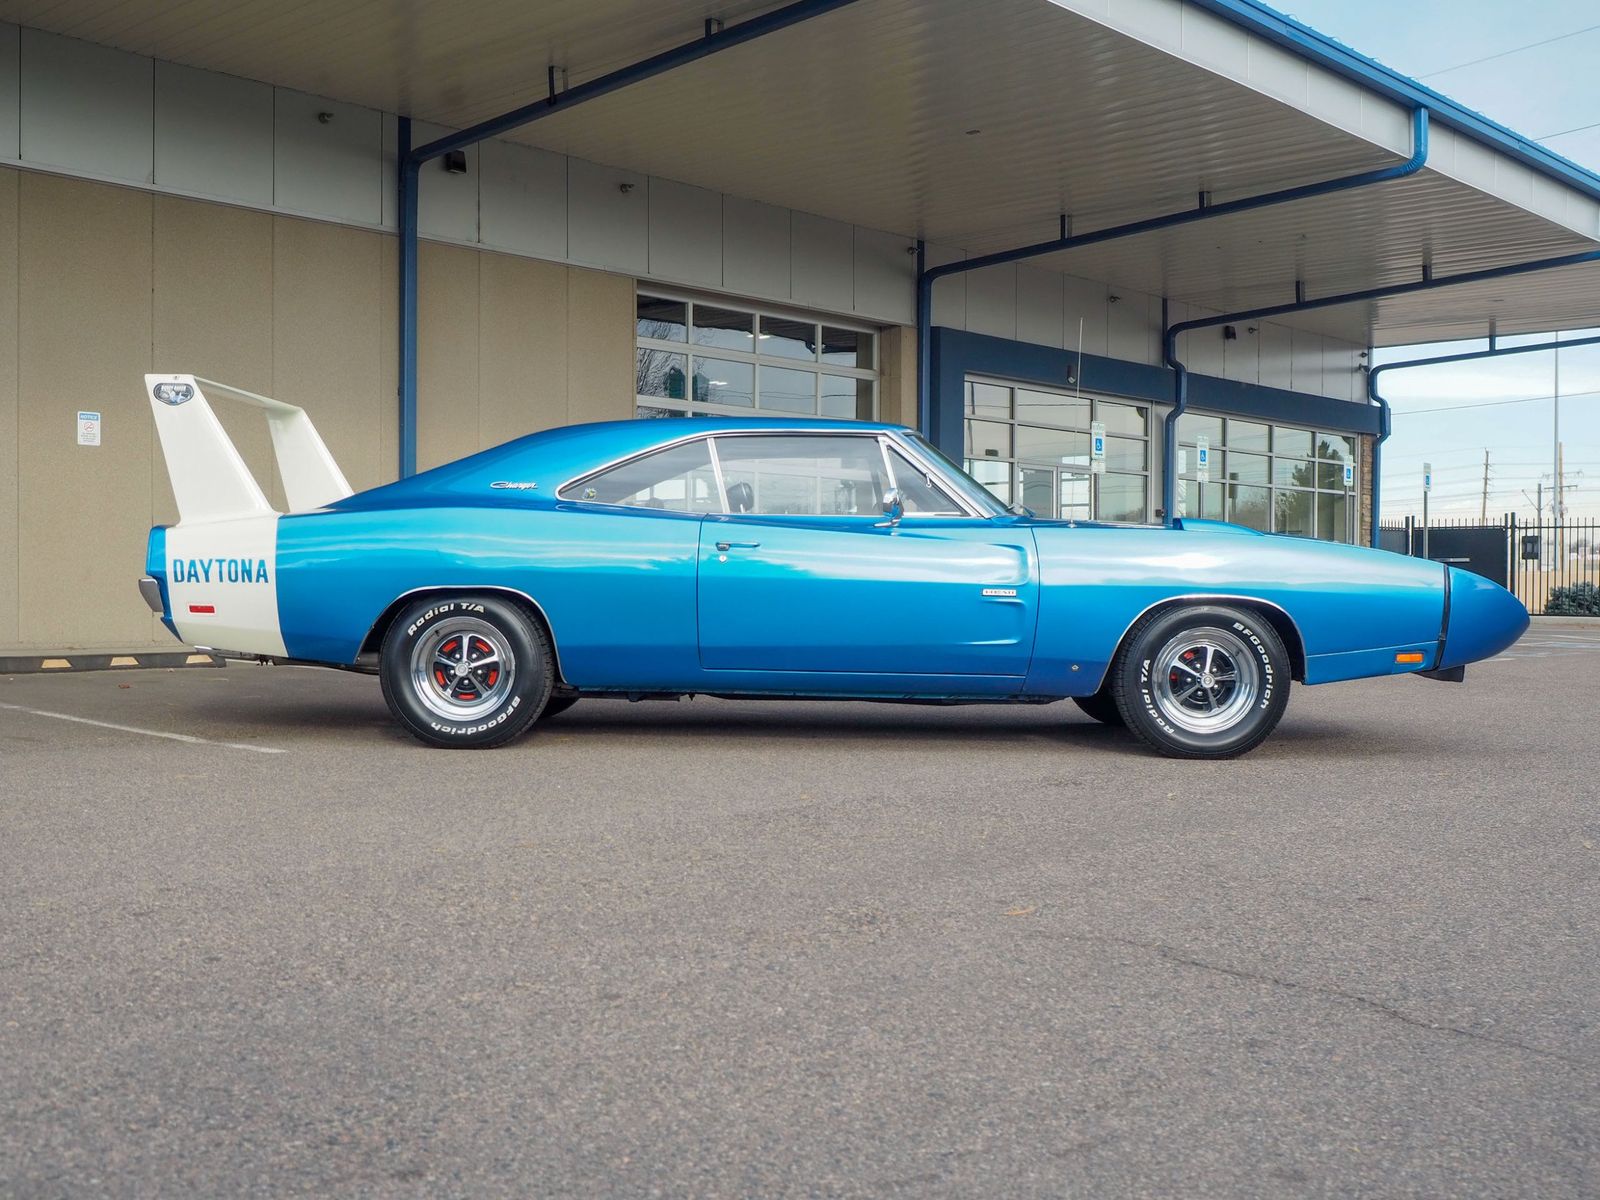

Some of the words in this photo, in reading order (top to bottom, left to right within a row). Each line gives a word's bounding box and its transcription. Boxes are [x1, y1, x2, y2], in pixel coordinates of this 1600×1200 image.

[173, 559, 268, 583] DAYTONA
[407, 602, 455, 636] Radial
[460, 602, 486, 614] T/A
[1140, 659, 1151, 683] T/A
[1232, 622, 1274, 709] BFGoodrich
[431, 695, 521, 735] BFGoodrich
[1141, 689, 1175, 734] Radial
